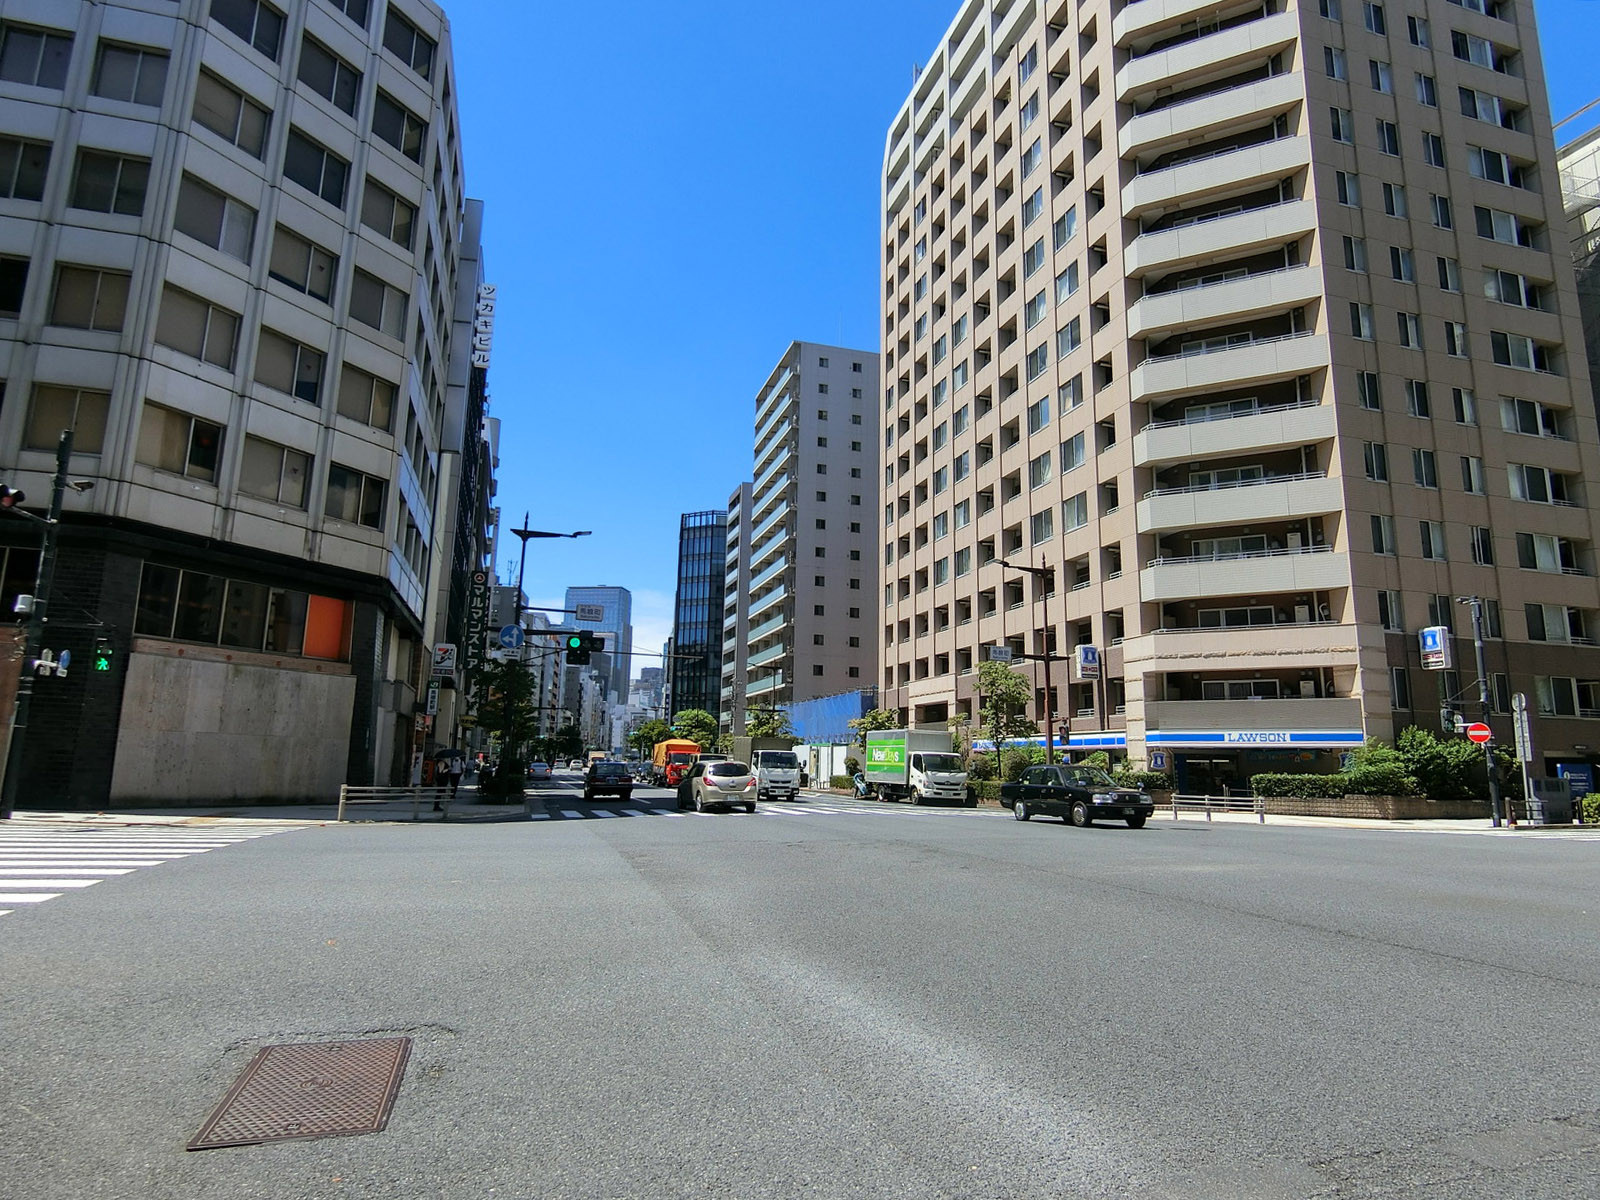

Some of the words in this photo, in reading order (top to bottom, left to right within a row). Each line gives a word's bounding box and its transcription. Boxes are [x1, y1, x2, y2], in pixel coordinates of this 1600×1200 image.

[476, 287, 495, 362] ツカキビル
[467, 584, 485, 669] マルマンストア
[872, 747, 899, 763] NewDays
[1228, 733, 1287, 742] LAWSON
